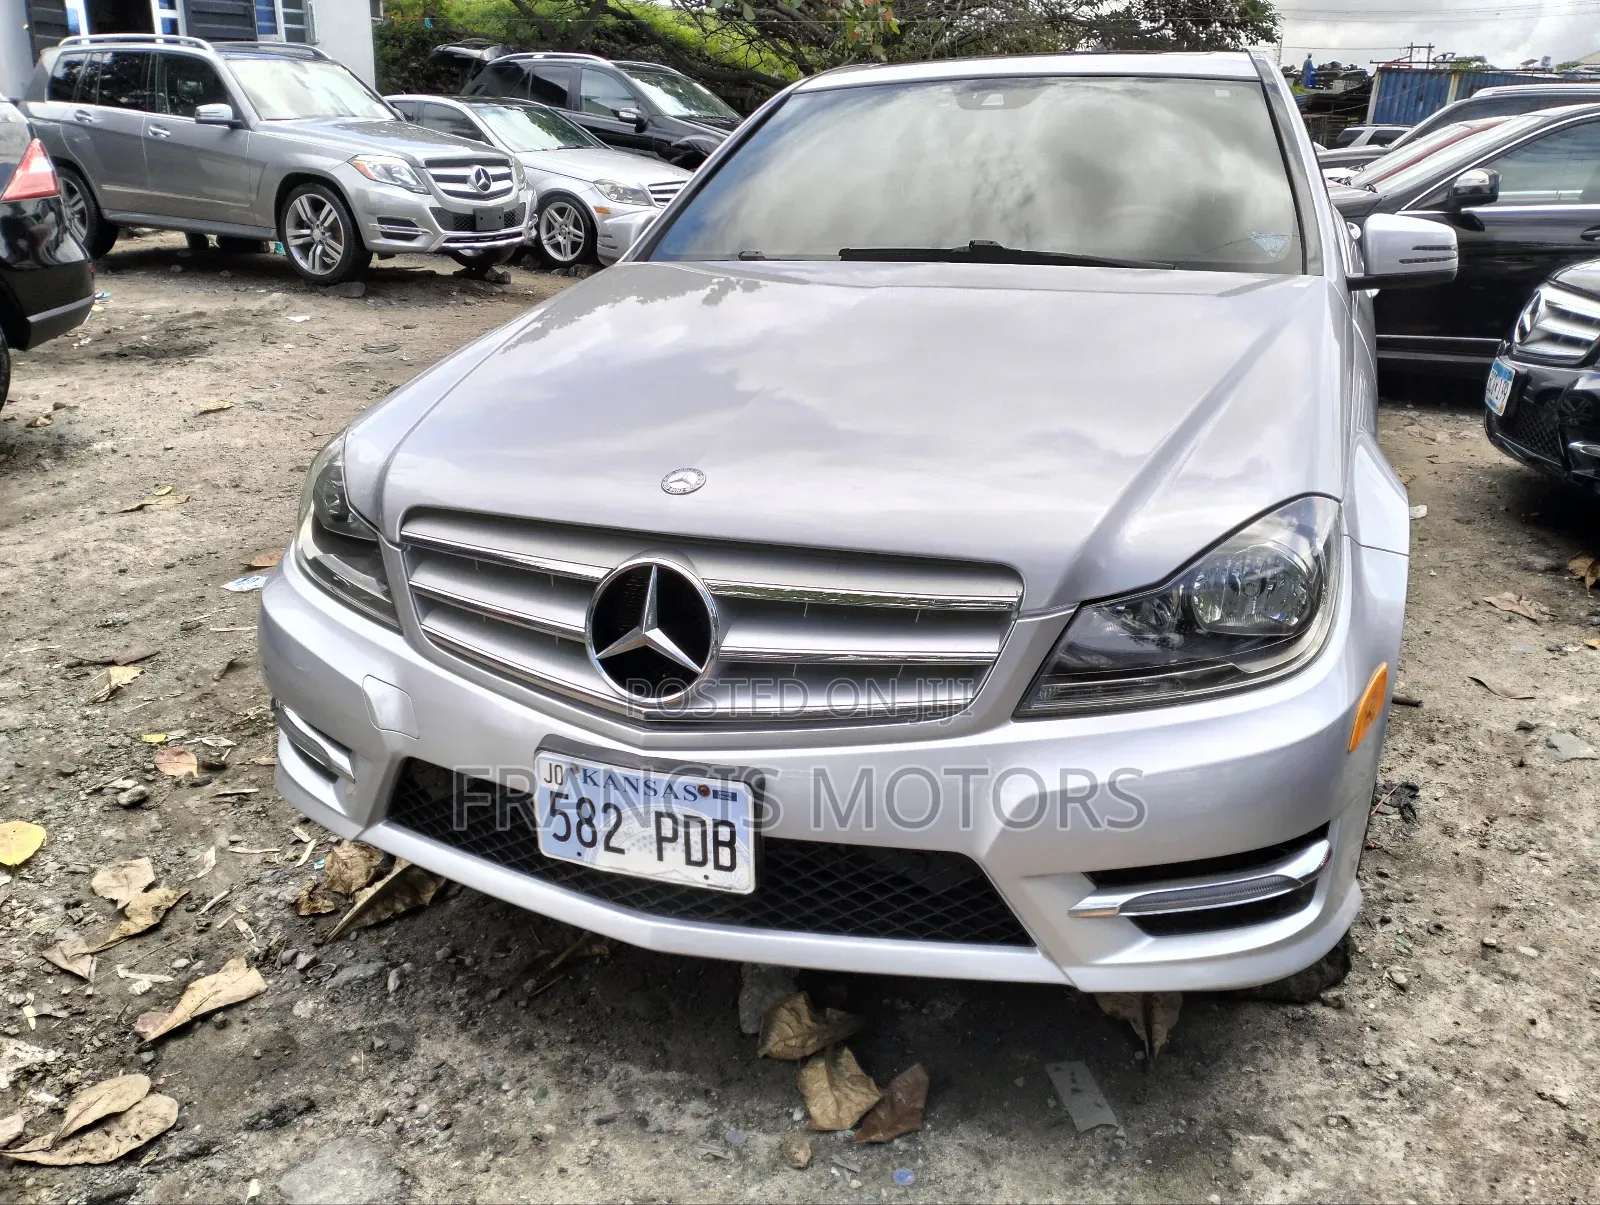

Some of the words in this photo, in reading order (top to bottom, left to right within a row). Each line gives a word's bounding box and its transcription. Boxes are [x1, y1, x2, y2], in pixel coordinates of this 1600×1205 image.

[543, 762, 565, 786] JO
[581, 767, 699, 803] KANSAS
[549, 790, 626, 855] 582
[654, 810, 738, 873] PDB
